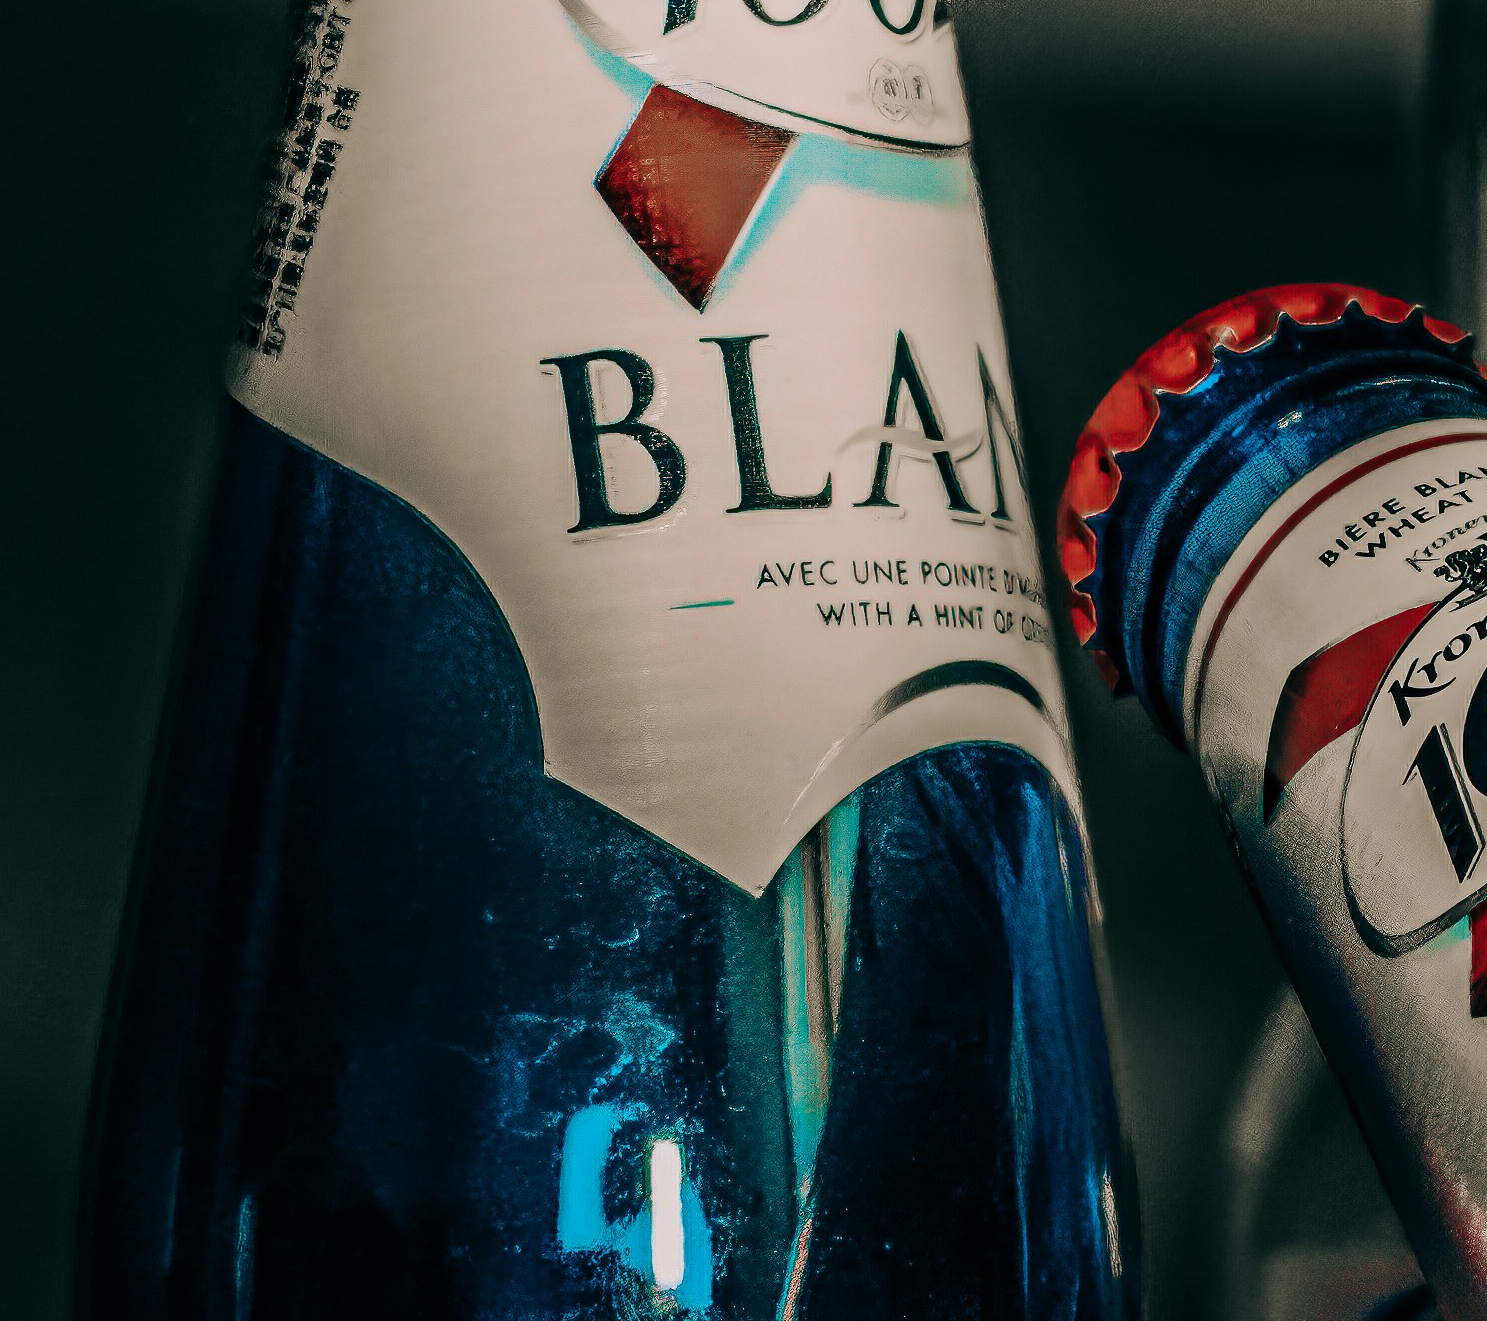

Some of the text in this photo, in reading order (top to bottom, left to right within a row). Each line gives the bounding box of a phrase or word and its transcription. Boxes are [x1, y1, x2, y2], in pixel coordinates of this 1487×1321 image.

[1318, 497, 1407, 568] BIÈRE
[1354, 489, 1474, 558] WHEAT
[756, 560, 838, 589] AVEC
[852, 560, 909, 585] UNE
[921, 561, 997, 592] POINTE
[817, 602, 893, 626] WITH
[907, 603, 924, 627] A
[934, 604, 984, 629] HINT
